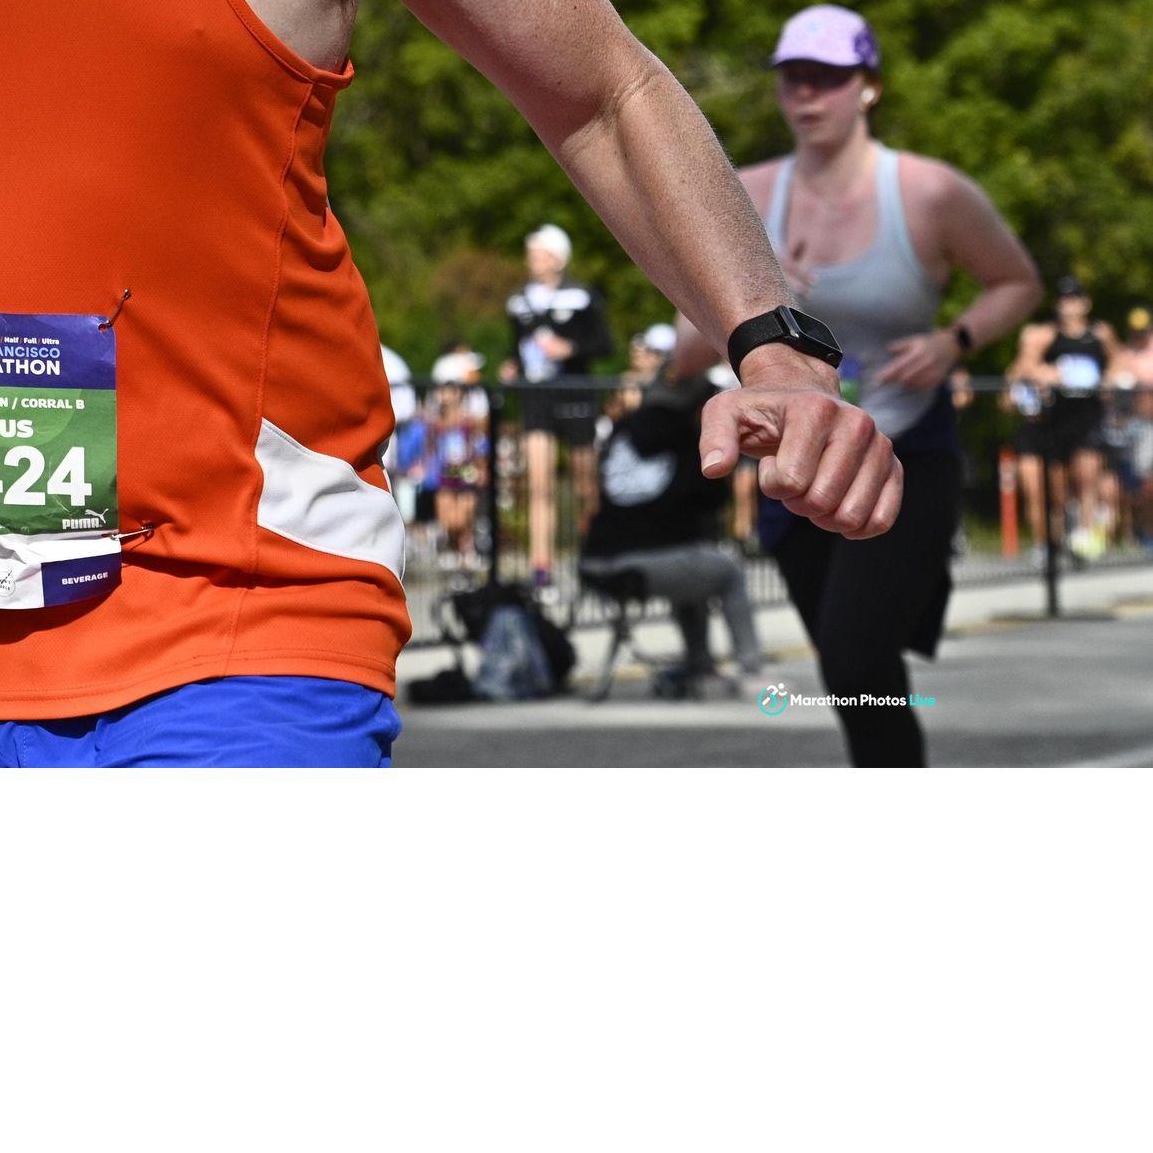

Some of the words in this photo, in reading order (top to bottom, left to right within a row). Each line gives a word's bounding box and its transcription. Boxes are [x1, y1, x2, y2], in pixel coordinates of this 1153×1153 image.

[4, 336, 20, 344] Half
[21, 398, 73, 409] CORRAL
[76, 399, 85, 410] B
[62, 517, 101, 530] PUMA
[61, 571, 109, 586] BEVERAGE
